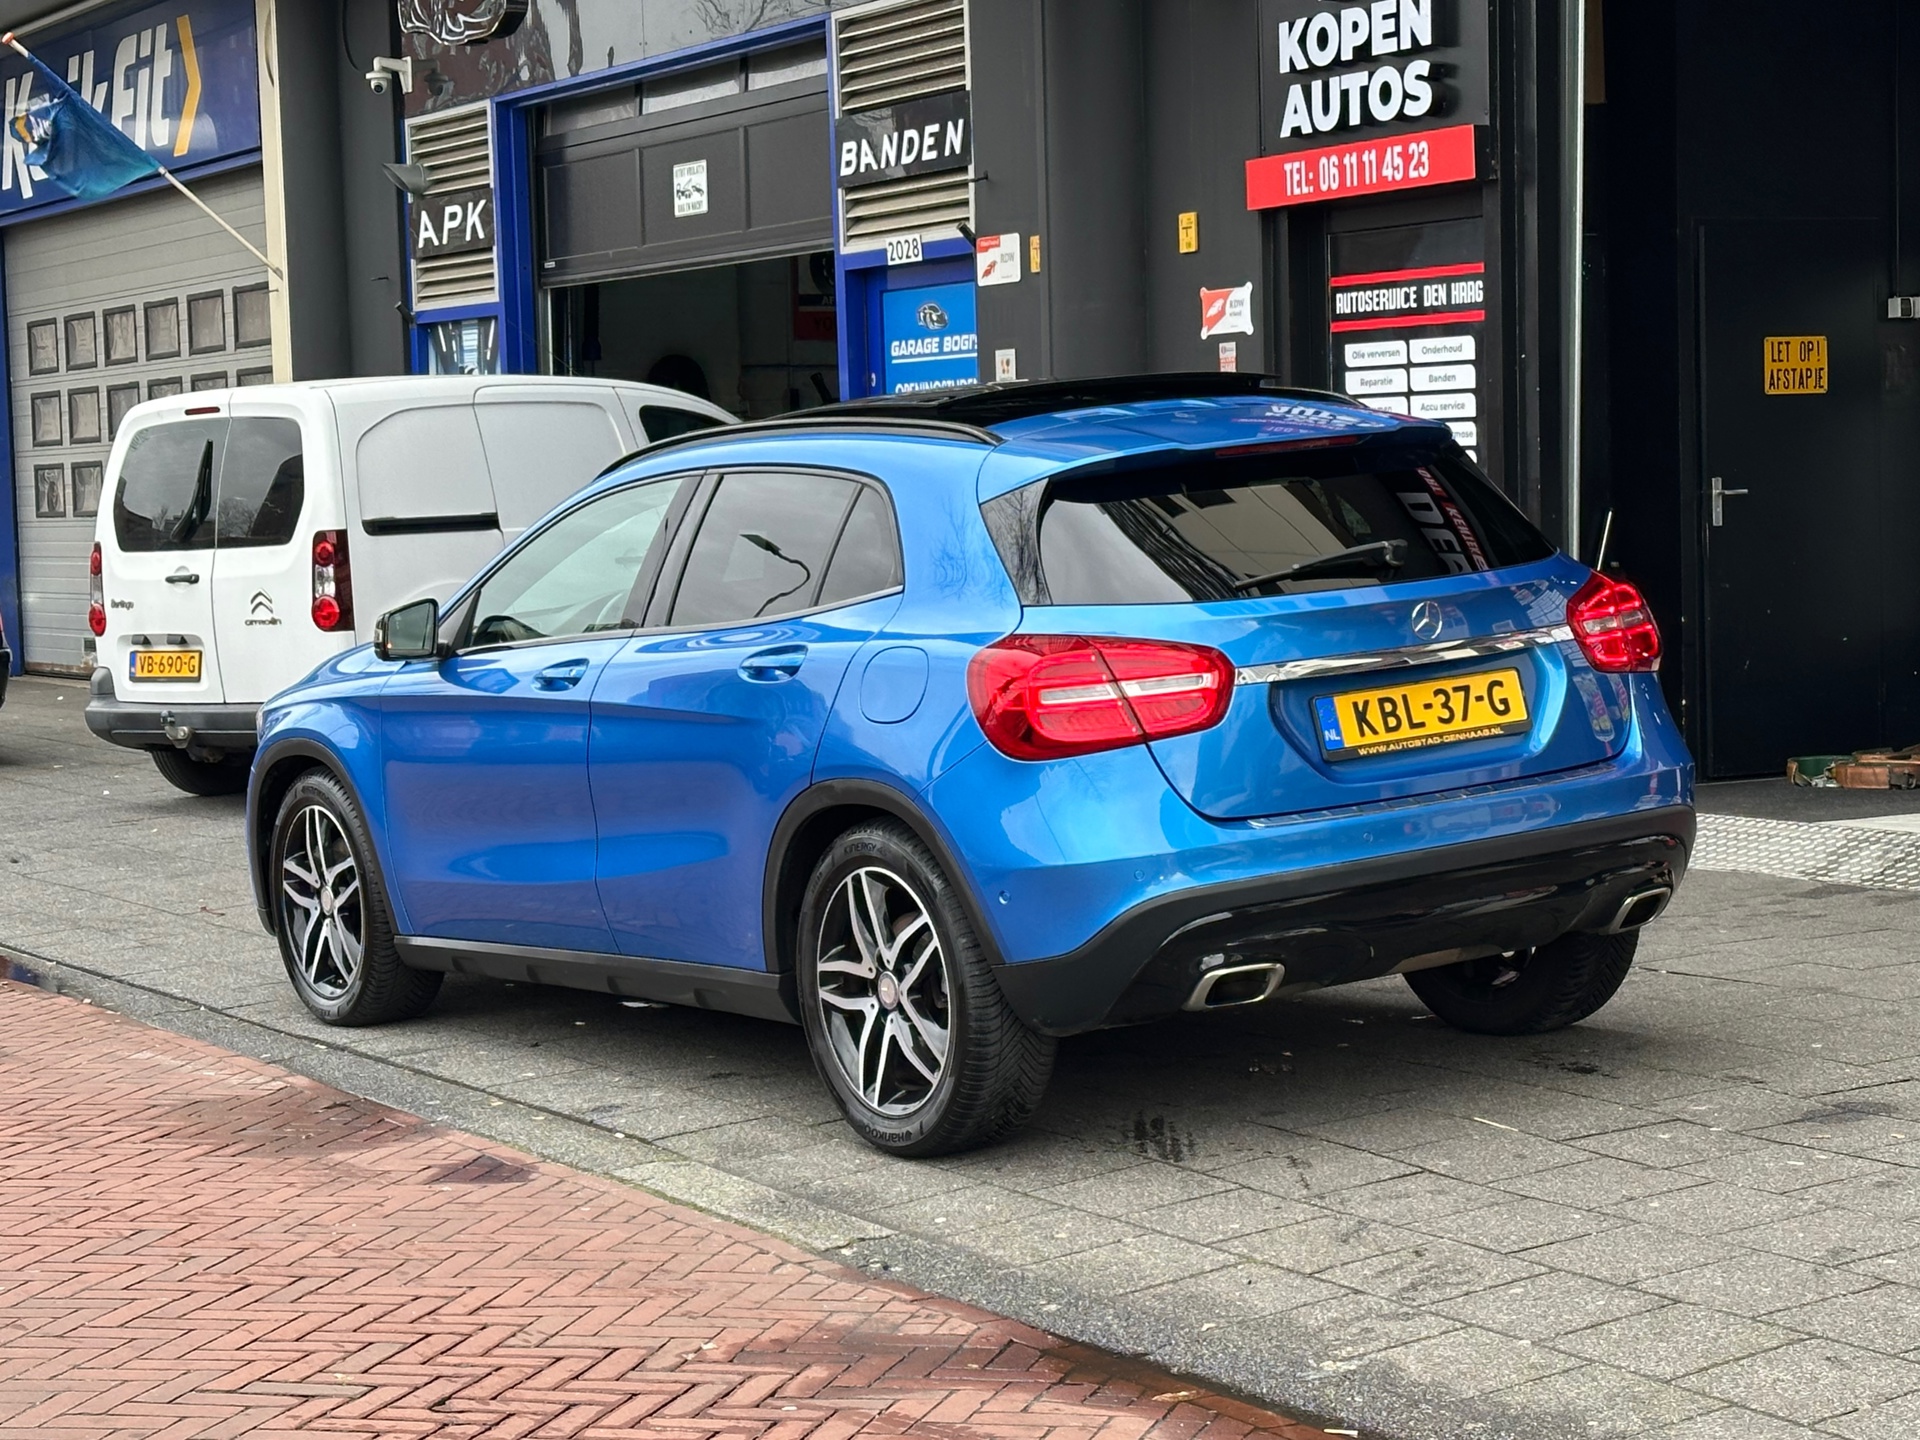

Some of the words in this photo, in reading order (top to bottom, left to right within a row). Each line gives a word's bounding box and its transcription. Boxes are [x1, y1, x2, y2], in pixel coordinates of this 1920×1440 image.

[1278, 0, 1433, 74] KOPEN
[1280, 60, 1433, 138] AUTOS
[840, 118, 965, 177] BANDEN
[1283, 160, 1314, 196] TEL:
[1318, 154, 1340, 192] 06
[1342, 151, 1358, 188] 11
[1361, 148, 1377, 185] 11
[1381, 144, 1404, 182] 45
[1408, 140, 1429, 179] 23
[418, 198, 487, 249] APK
[888, 238, 920, 262] 2028
[1423, 283, 1447, 307] DEN
[1451, 280, 1484, 305] HAAG
[891, 337, 940, 357] GARAGE
[943, 334, 978, 353] BOGI'
[1352, 350, 1365, 360] Olie
[1367, 348, 1400, 359] verversen
[1421, 343, 1463, 355] Onderhoud
[1771, 341, 1791, 363] LET
[1800, 340, 1821, 362] OP!
[1360, 376, 1393, 388] Reparatie
[1428, 373, 1457, 383] Banden
[1769, 367, 1825, 390] AFSTAPJE
[1420, 401, 1438, 412] Accu
[1440, 400, 1466, 411] service
[139, 655, 196, 674] VB-690-G
[1352, 680, 1511, 738] KBL-37-G
[1324, 729, 1341, 742] NL
